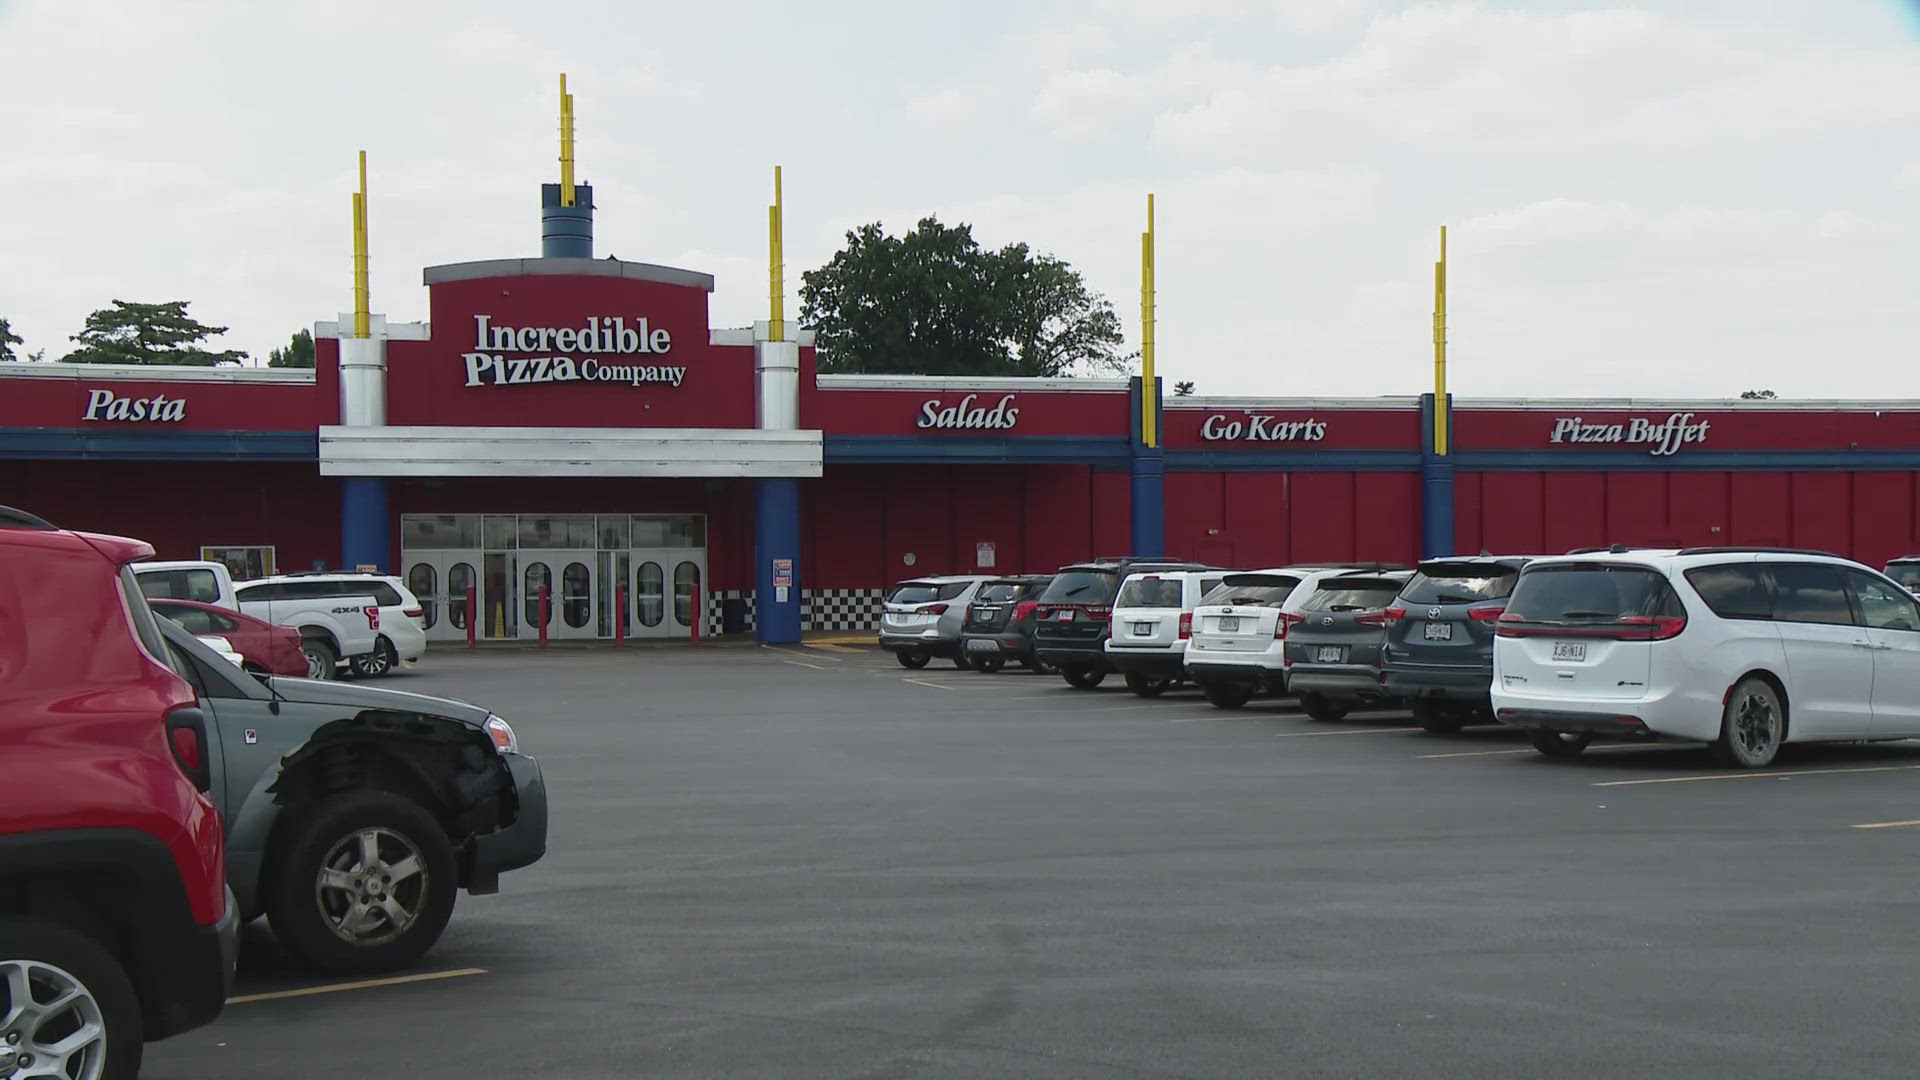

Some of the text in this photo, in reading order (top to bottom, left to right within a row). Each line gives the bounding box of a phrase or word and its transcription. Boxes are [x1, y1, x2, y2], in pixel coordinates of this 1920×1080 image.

[473, 314, 672, 354] Incredible
[461, 352, 687, 387] Pizza Company
[81, 389, 187, 422] Pasta
[917, 393, 1020, 429] Salads
[1202, 414, 1328, 441] Go Karts
[1550, 412, 1711, 456] Pizza Buffet
